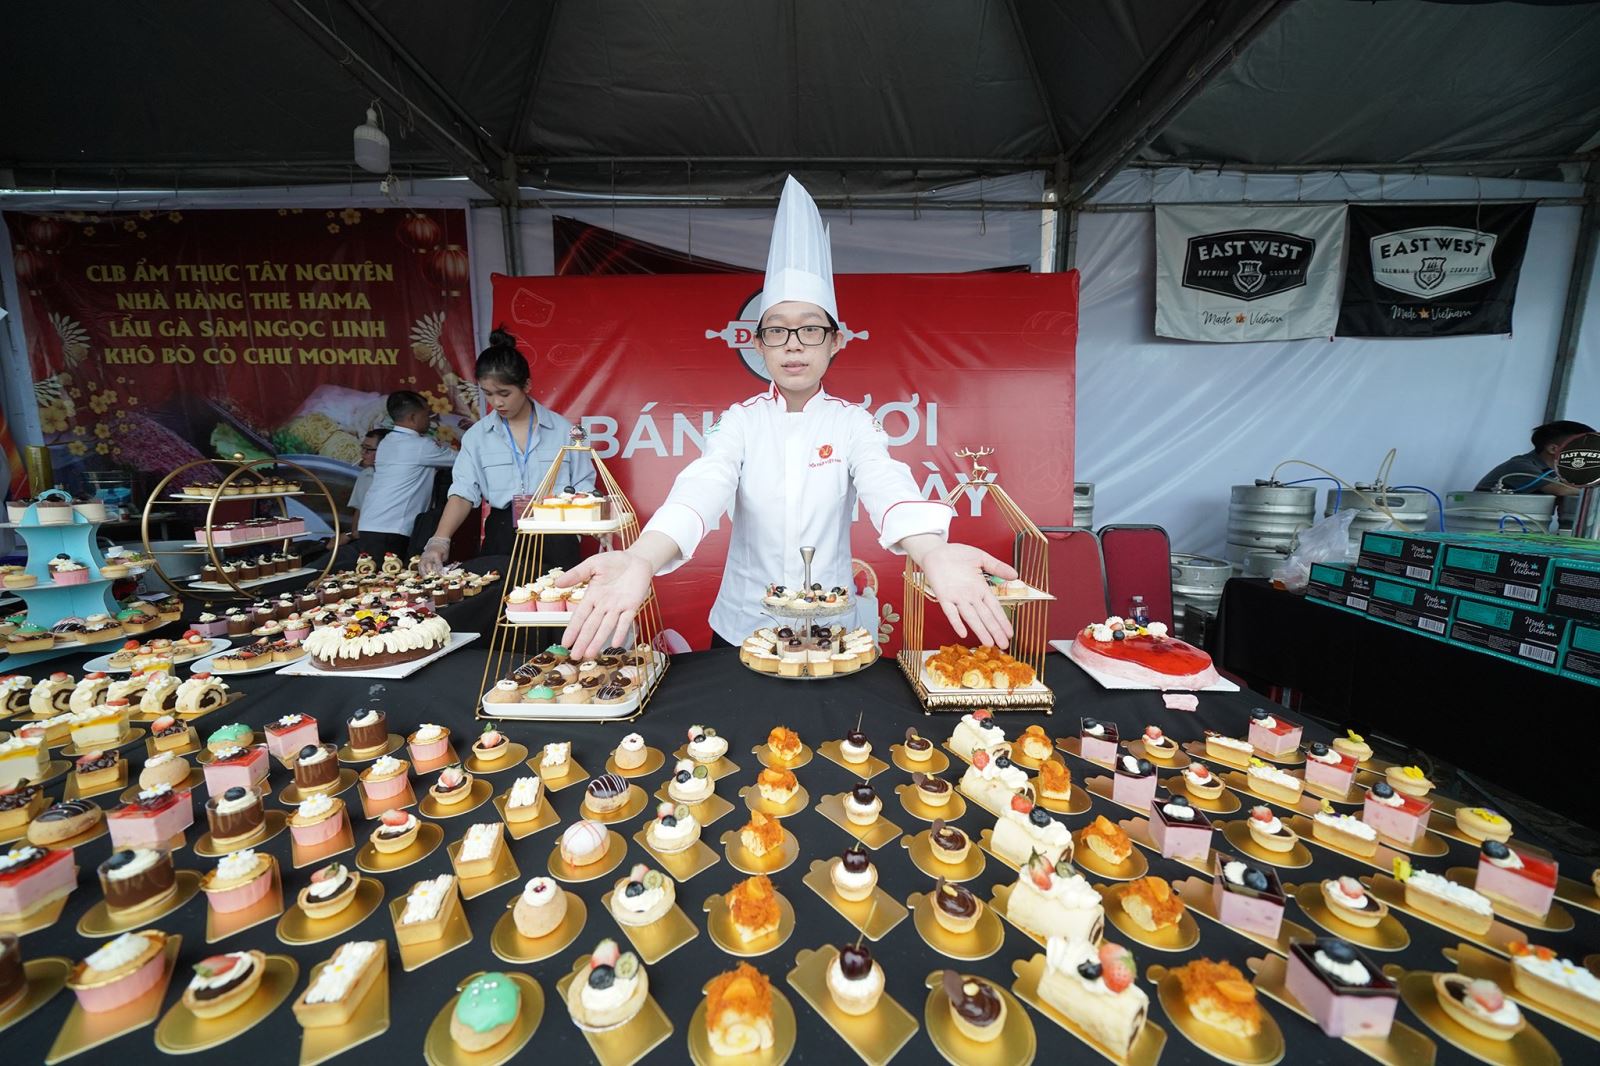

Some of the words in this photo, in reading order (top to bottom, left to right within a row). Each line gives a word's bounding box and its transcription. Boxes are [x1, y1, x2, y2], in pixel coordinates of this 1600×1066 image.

[1198, 240, 1245, 261] EAST
[1249, 240, 1303, 260] WEST
[1380, 237, 1429, 259] EAST
[1433, 237, 1486, 257] WEST
[86, 265, 126, 282] CLB
[133, 258, 169, 282] ẨM
[176, 262, 241, 285] THỰC
[245, 261, 289, 281] TÂY
[294, 261, 394, 281] NGUYÊN
[116, 289, 170, 310] NHÀ
[175, 289, 243, 310] HÀNG
[250, 293, 292, 310] THE
[299, 293, 372, 310] HAMA
[1202, 310, 1232, 325] Made
[1249, 311, 1284, 325] Vietnam
[1391, 305, 1417, 320] Made
[1431, 307, 1472, 320] Vietnam
[109, 313, 152, 338] LẨU
[158, 316, 193, 338] GÀ
[199, 316, 249, 338] SÂM
[255, 320, 326, 341] NGỌC
[332, 320, 386, 338] LINH
[104, 344, 155, 365] KHÔ
[162, 346, 196, 365] BÒ
[243, 347, 292, 365] CHƯ
[299, 347, 400, 366] MOMRAY
[581, 402, 725, 460] BÁN
[1509, 558, 1530, 570] Made
[1514, 566, 1541, 577] Vietnam
[1524, 615, 1545, 629] Made
[1528, 626, 1558, 637] Vietnam
